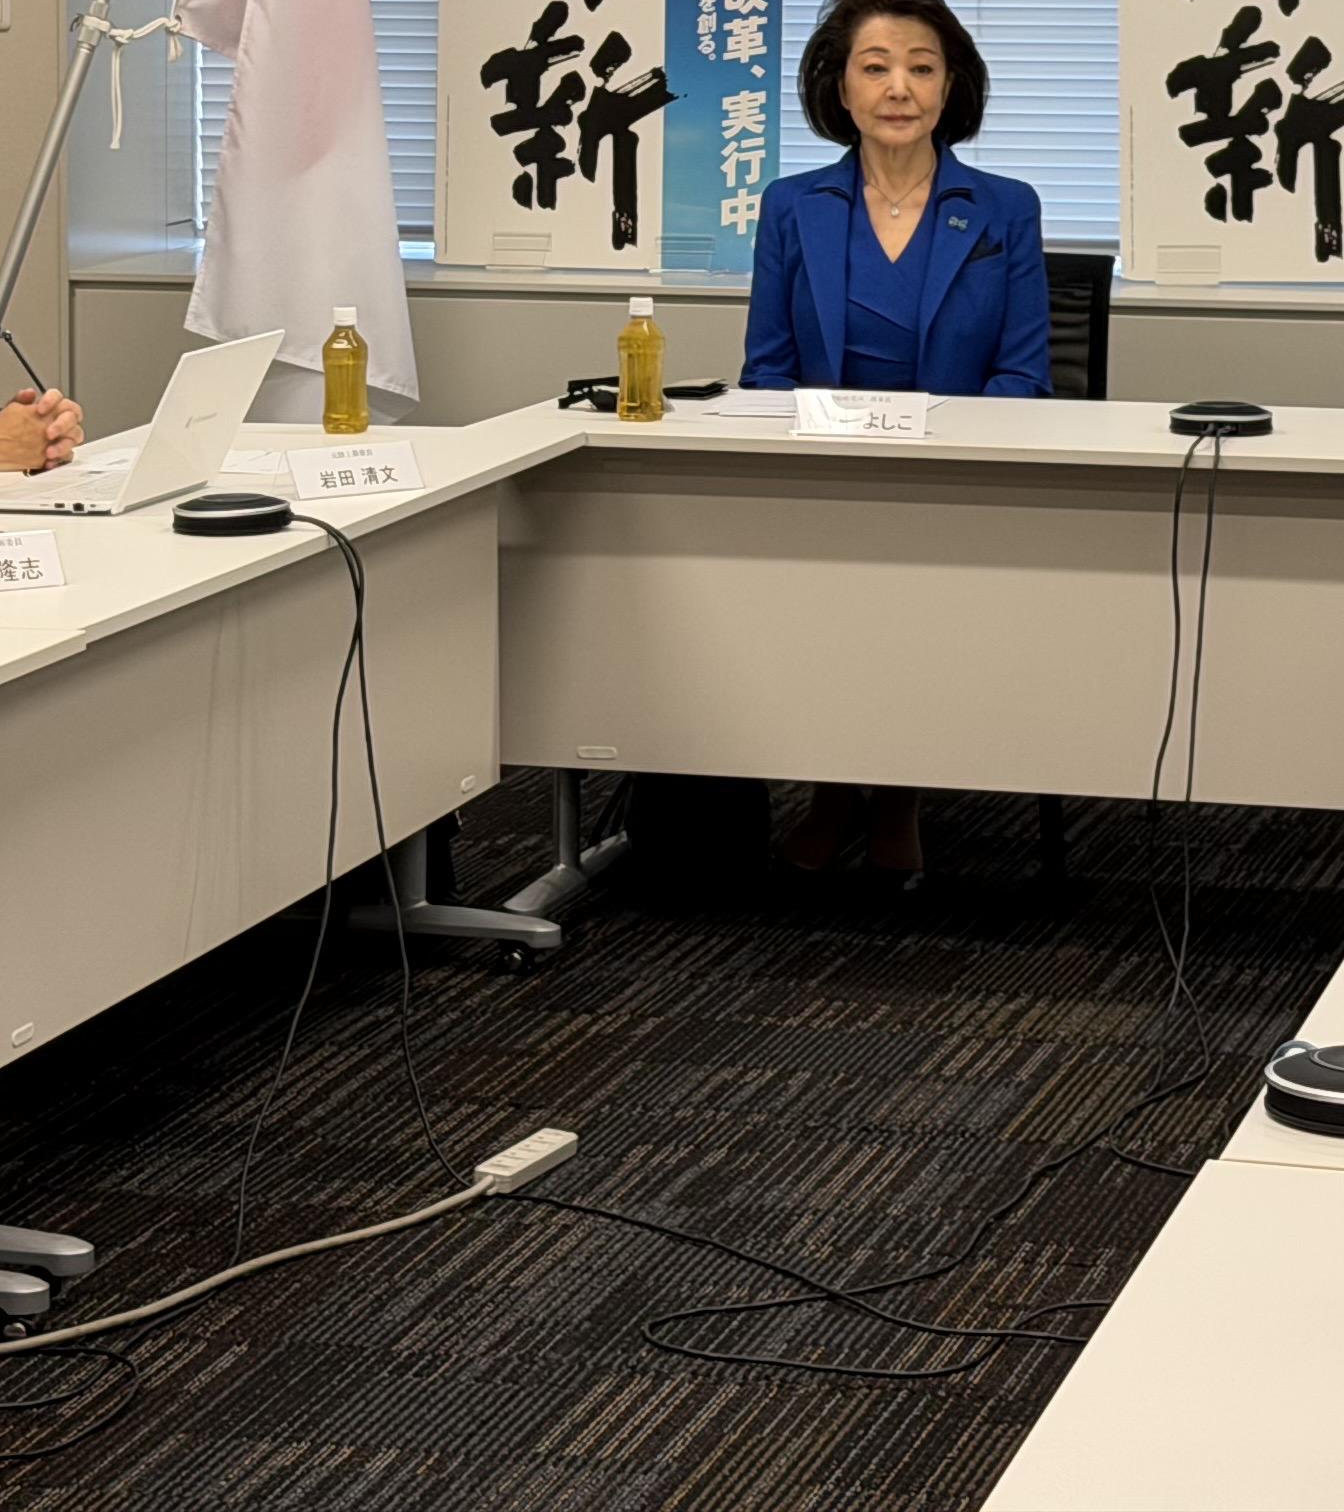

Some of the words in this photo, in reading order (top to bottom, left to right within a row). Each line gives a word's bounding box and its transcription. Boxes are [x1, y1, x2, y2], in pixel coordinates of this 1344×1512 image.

[862, 412, 913, 431] よしこ
[319, 469, 357, 489] 岩田
[360, 465, 399, 486] 清文
